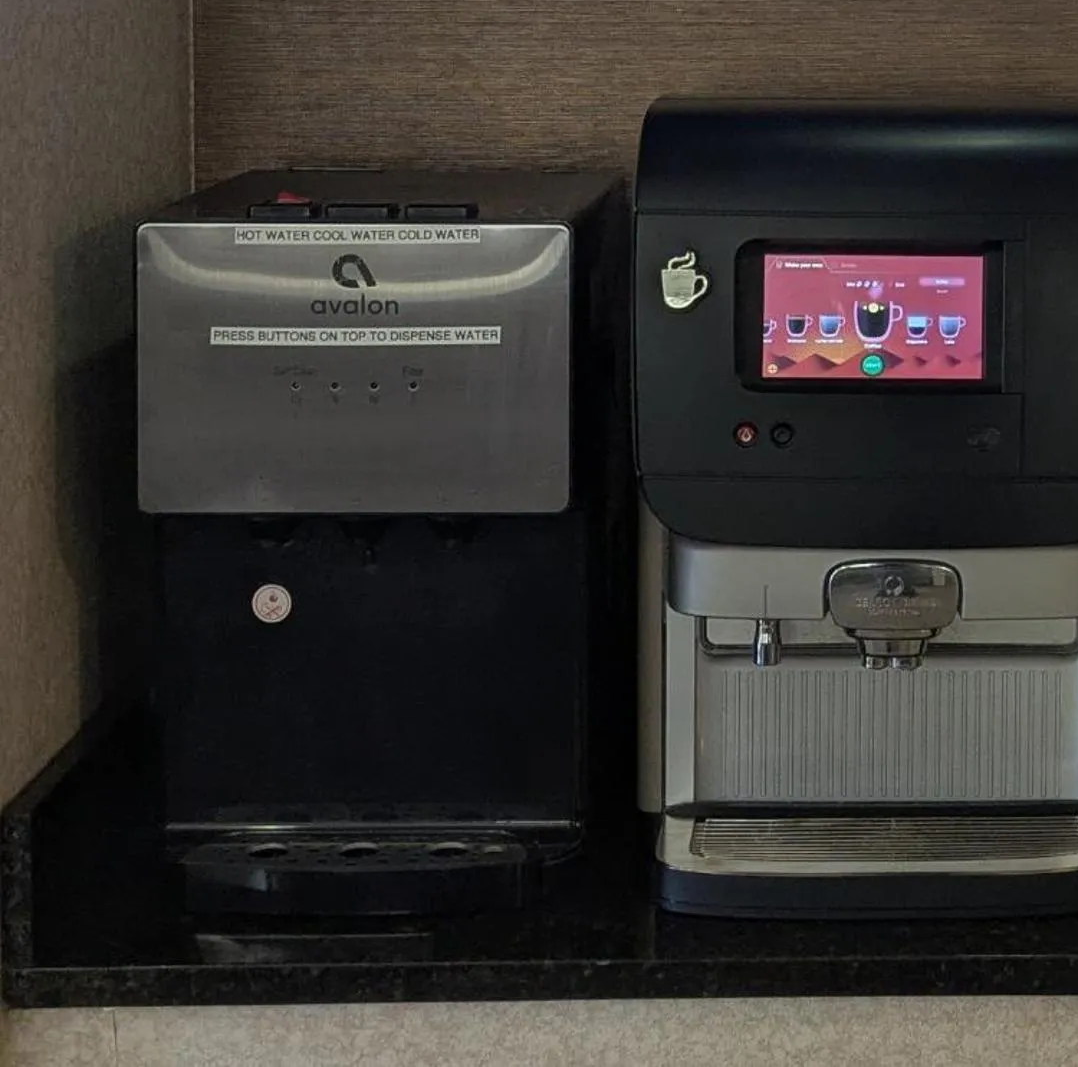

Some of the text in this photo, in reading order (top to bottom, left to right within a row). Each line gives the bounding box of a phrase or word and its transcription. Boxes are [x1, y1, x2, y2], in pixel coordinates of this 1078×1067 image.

[236, 227, 480, 242] HOT WATER COOL WATER COLD WATER
[310, 293, 399, 315] avalon
[213, 329, 499, 342] PRESS BUTTONS ON TOP TO DISPENSE WATER
